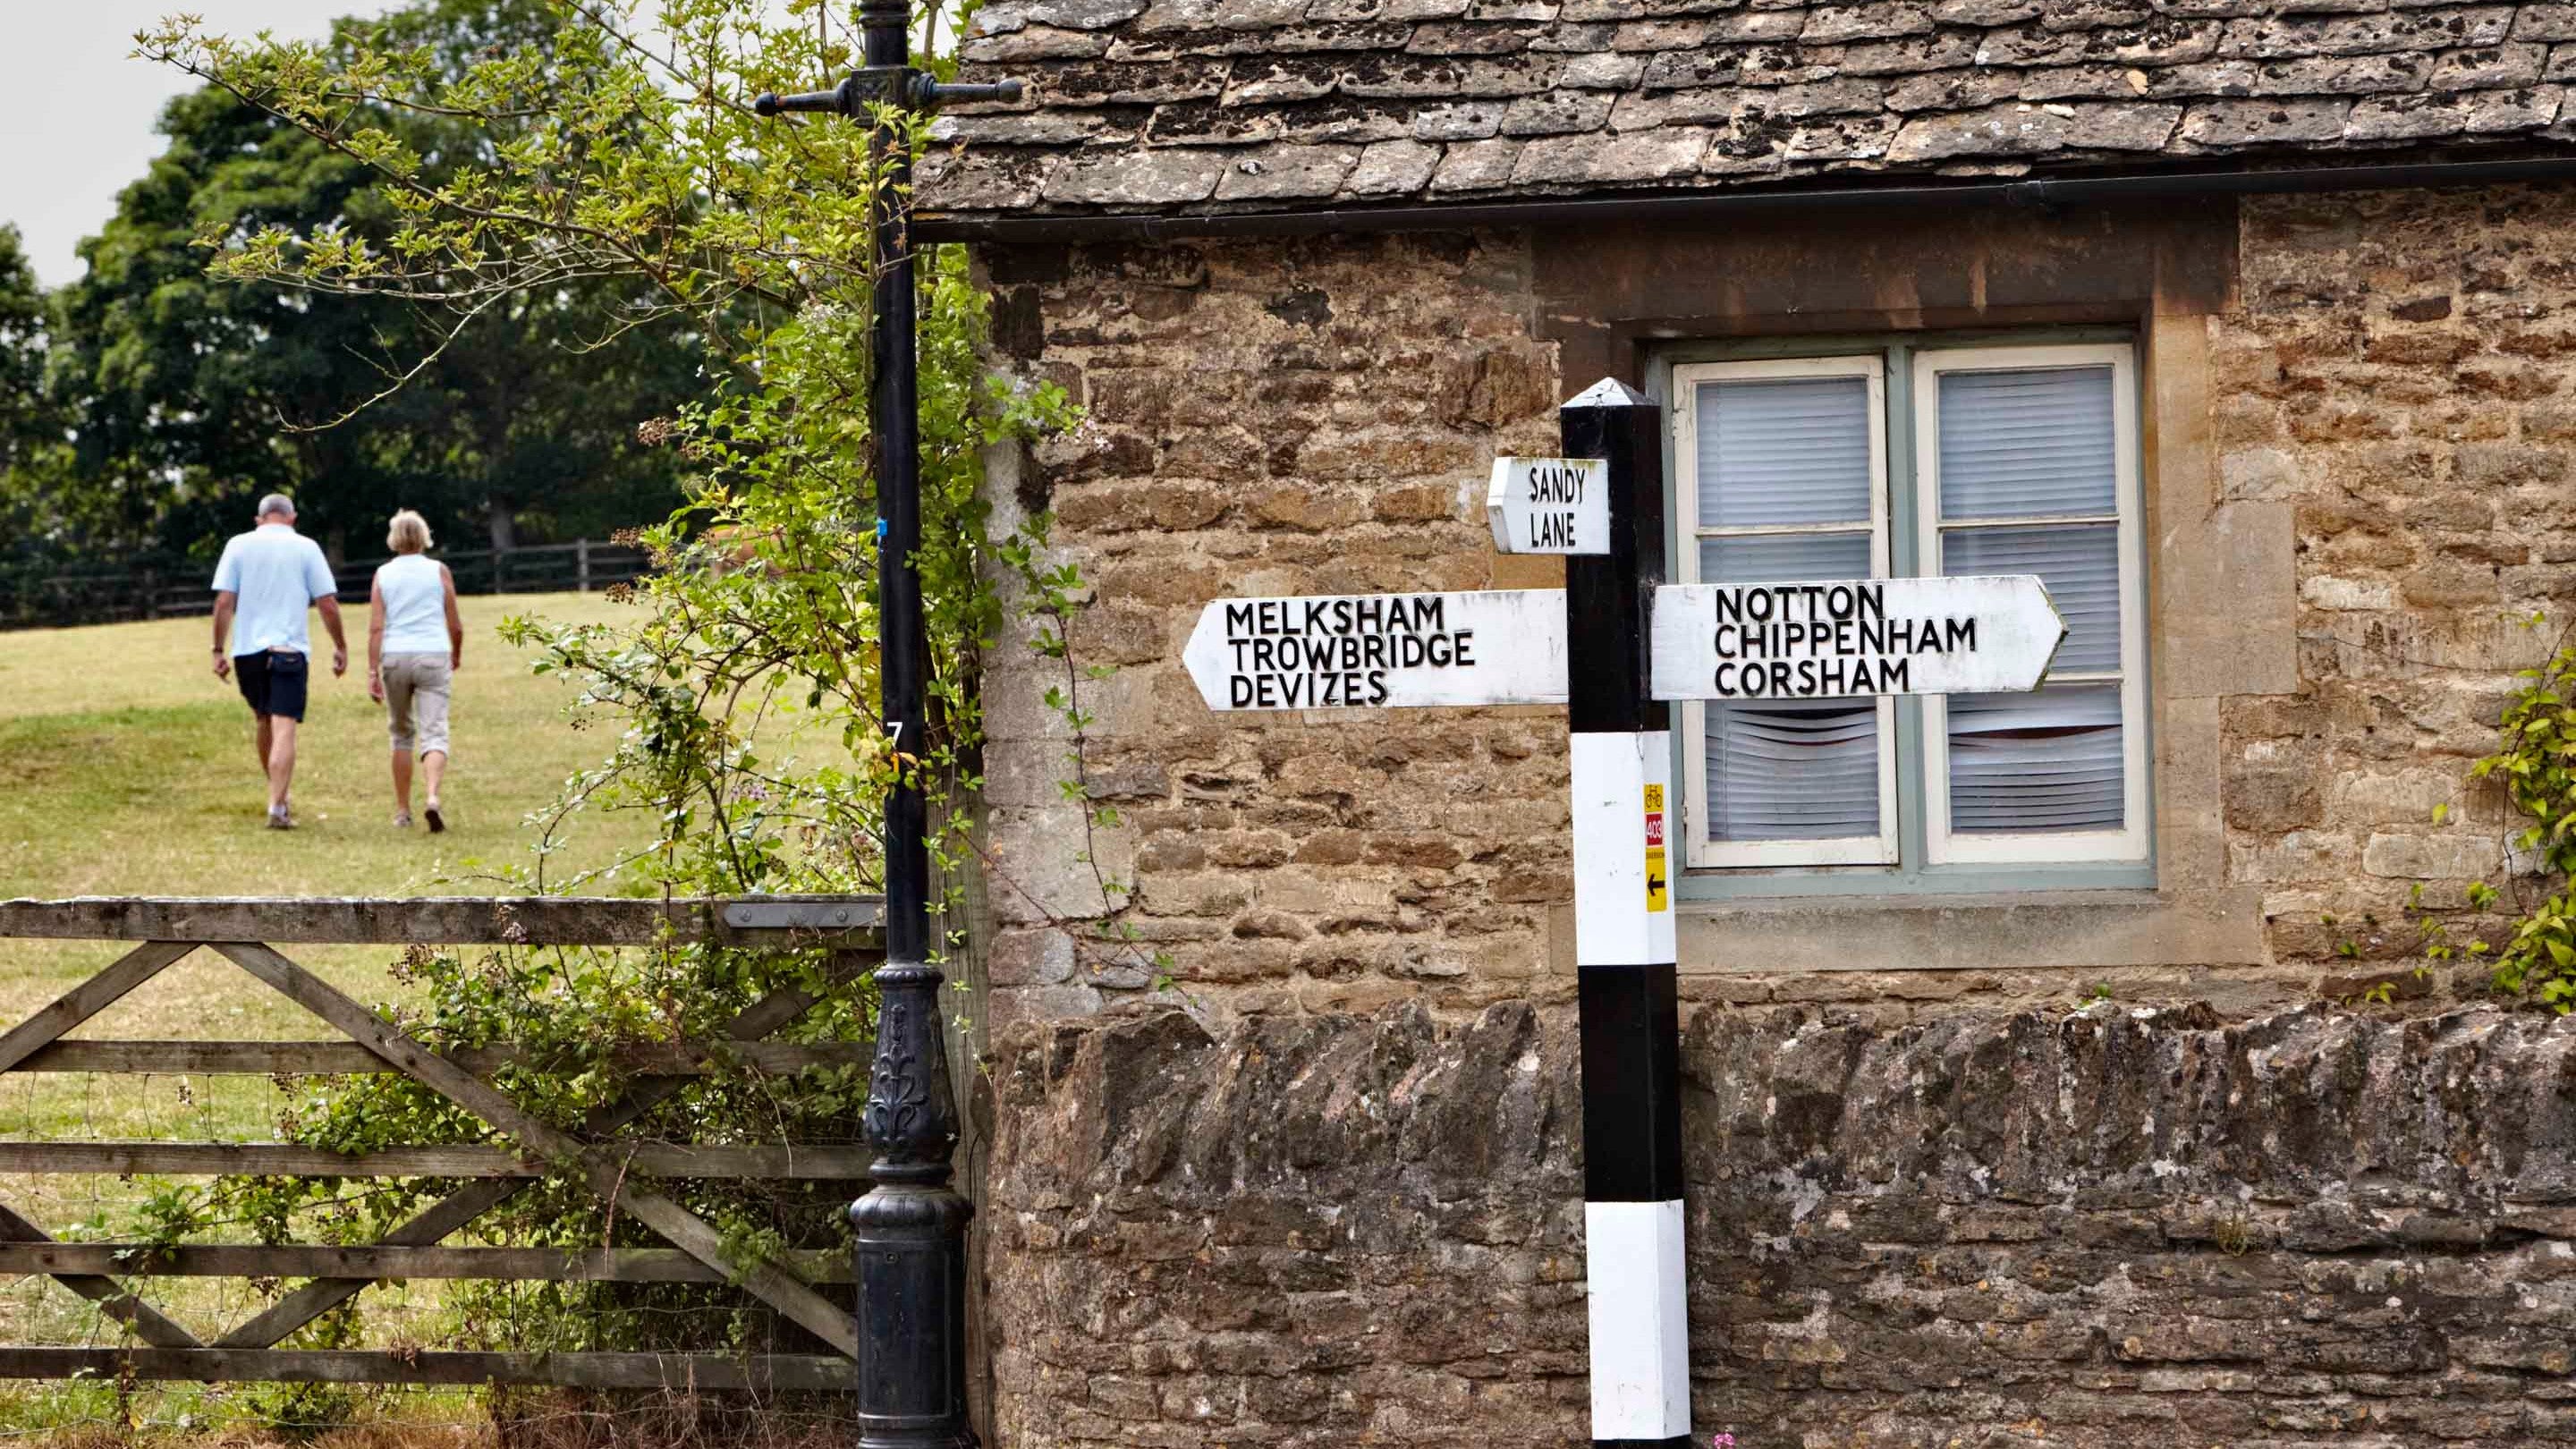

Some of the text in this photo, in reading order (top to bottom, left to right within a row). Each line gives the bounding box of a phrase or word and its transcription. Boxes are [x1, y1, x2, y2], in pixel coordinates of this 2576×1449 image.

[1530, 467, 1586, 504] SANDY
[1530, 513, 1576, 547] LANE
[1226, 597, 1444, 636] MELKSHAM
[1716, 584, 1885, 623] NOTTON
[1228, 628, 1475, 672] TROWBRIDGE
[1715, 617, 1977, 659] CHIPPENHAM
[1231, 670, 1387, 708] DEVIZES
[1715, 657, 1911, 696] CORSHAM
[887, 722, 902, 750] 7
[1647, 820, 1661, 838] 403
